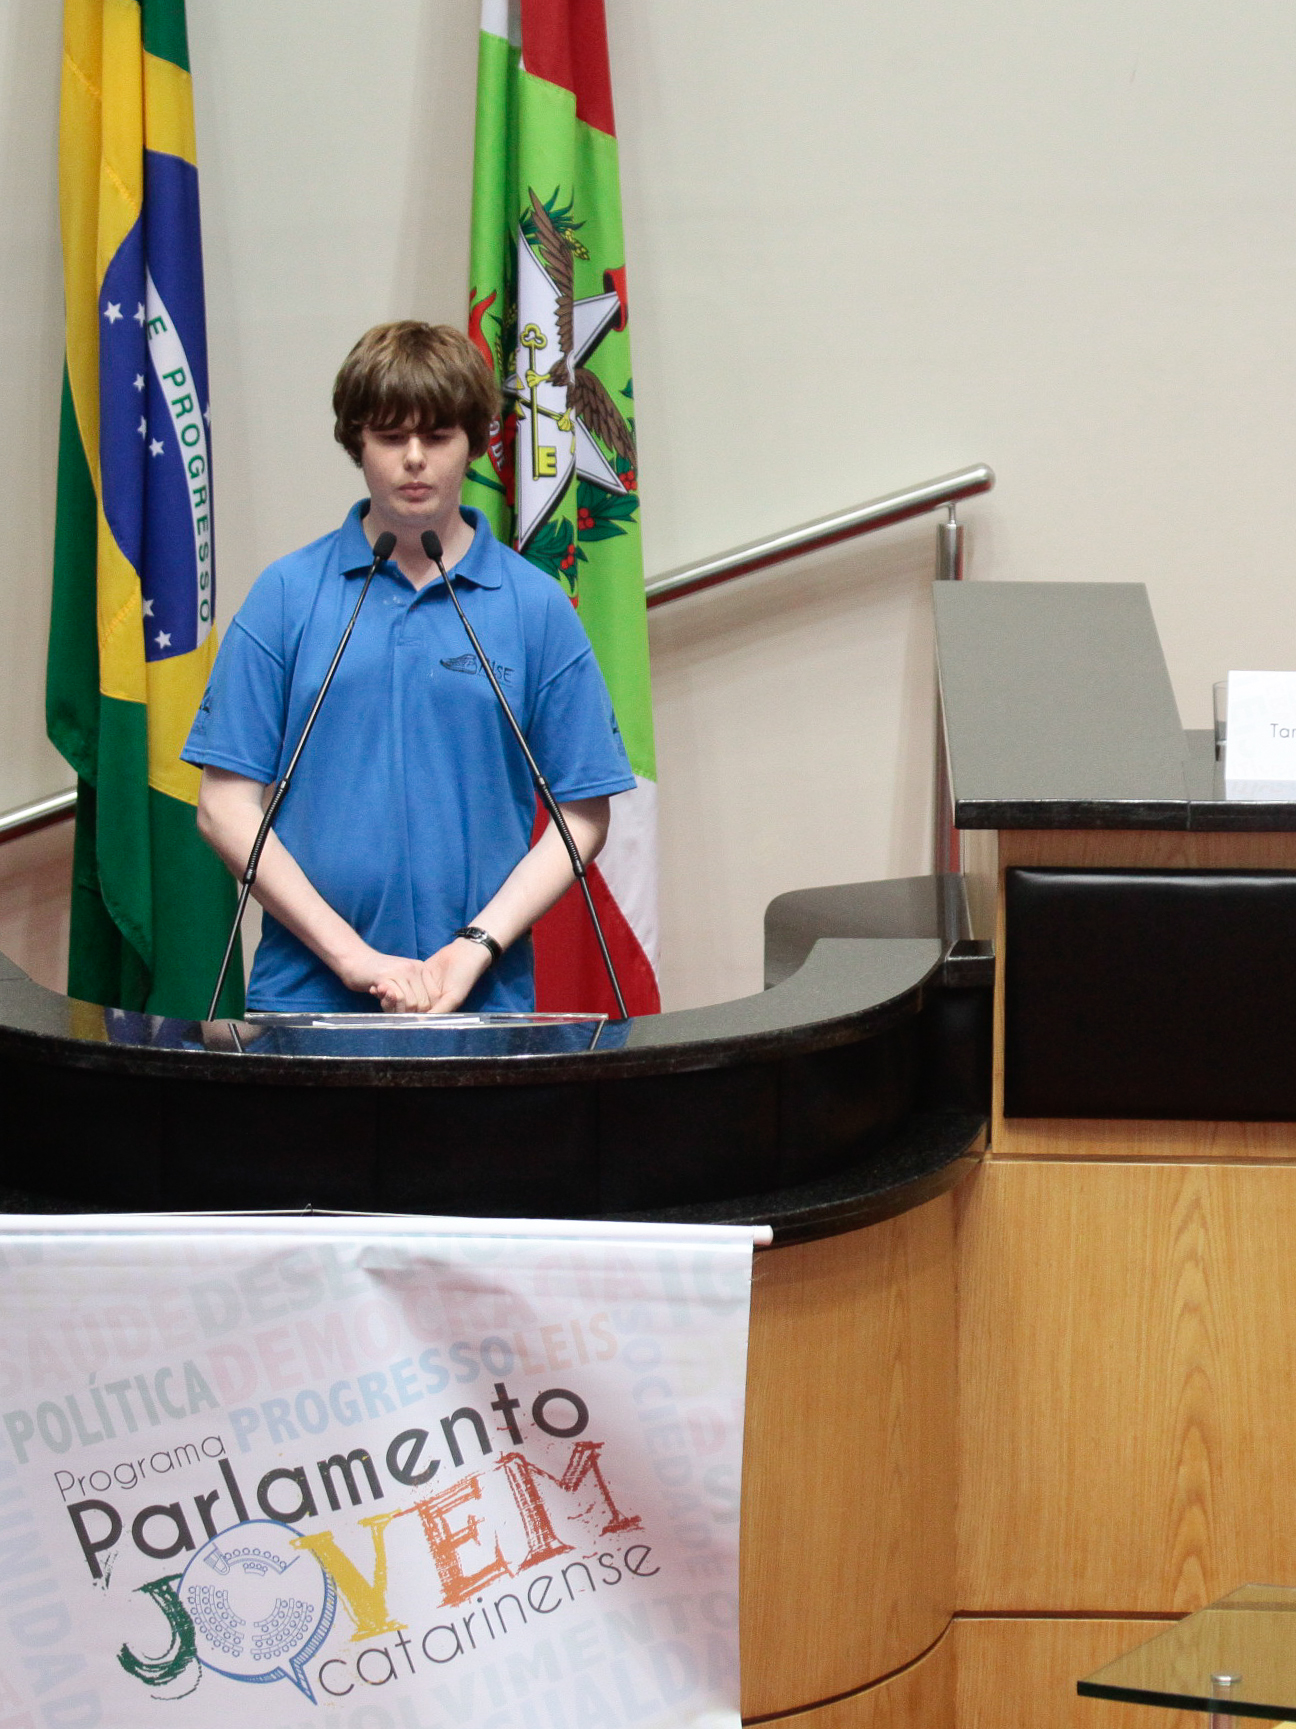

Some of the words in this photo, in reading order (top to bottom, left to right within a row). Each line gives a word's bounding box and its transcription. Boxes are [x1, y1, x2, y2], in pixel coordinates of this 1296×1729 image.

[162, 366, 212, 623] PROGRESSO
[205, 1252, 650, 1405] DEMOCRACIA
[228, 1335, 515, 1454] PROGRESSO
[513, 1311, 619, 1377] LEIS
[2, 1359, 221, 1466] POLÍTICA
[54, 1435, 226, 1502] Programa
[67, 1382, 590, 1580] Parlamento
[117, 1440, 645, 1701] JOVEM
[318, 1544, 662, 1697] catarinense
